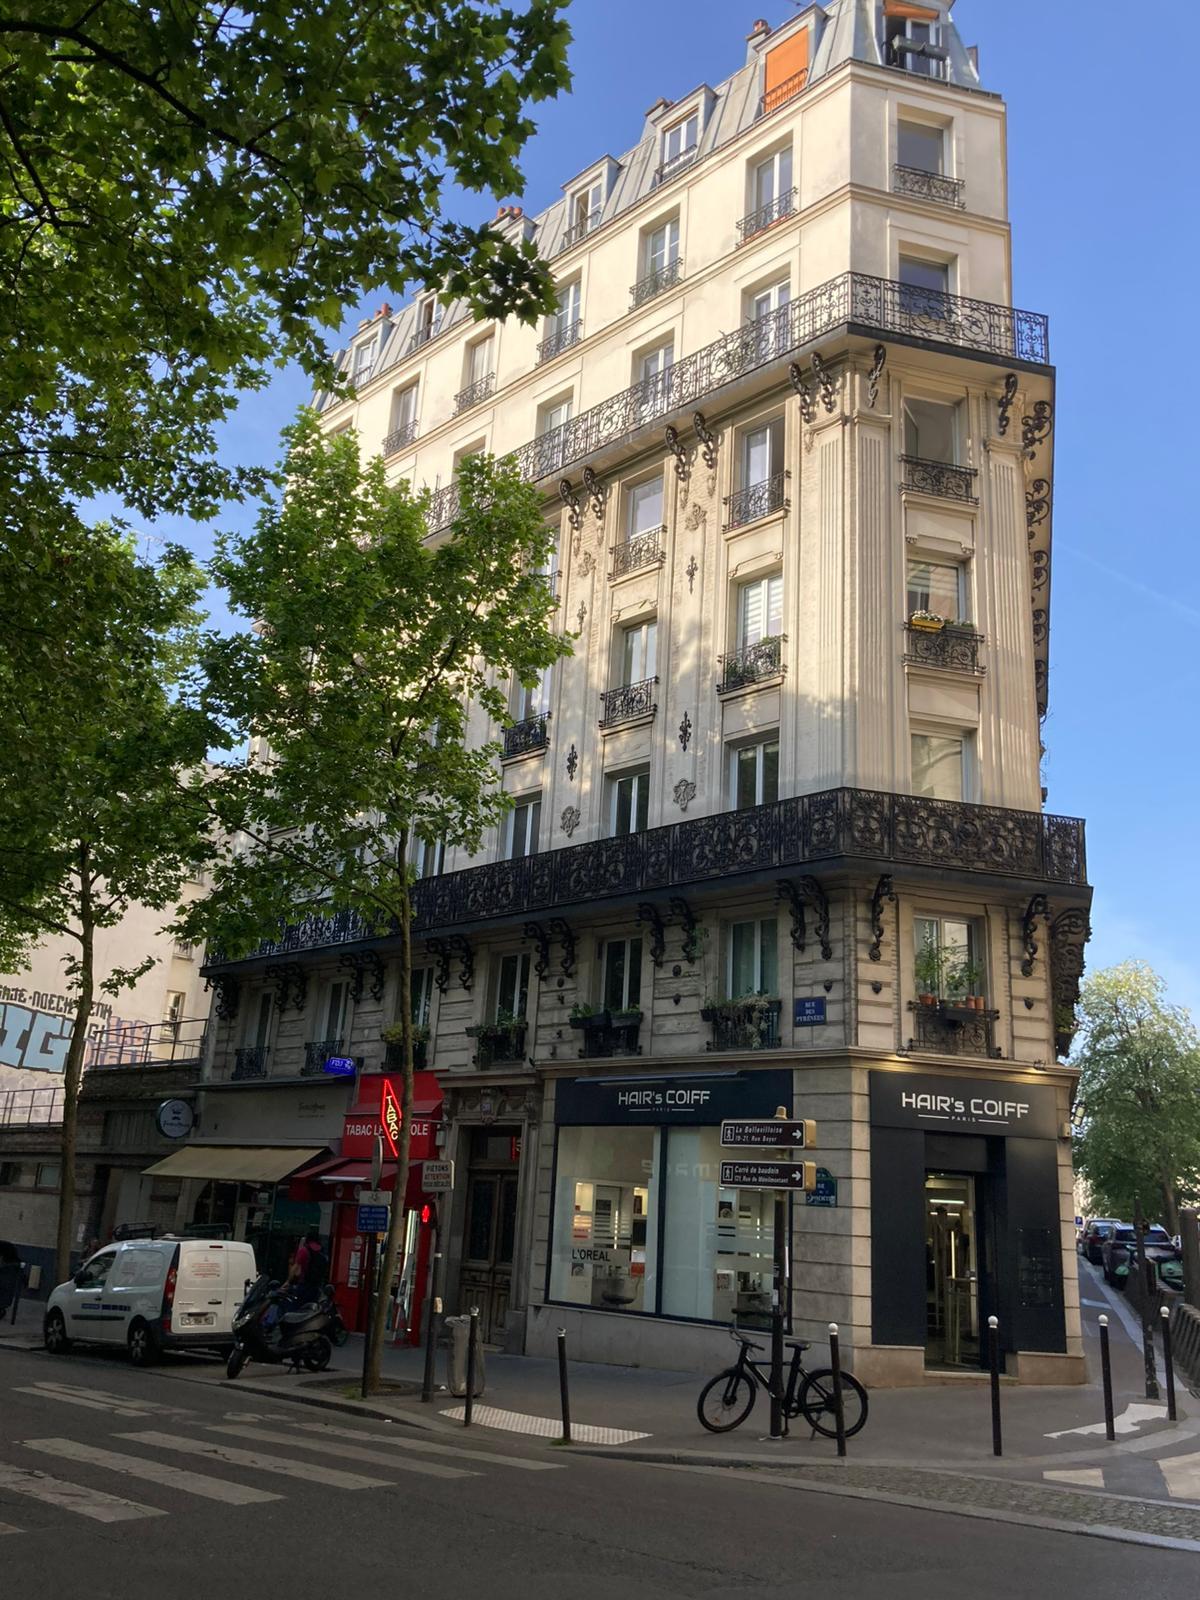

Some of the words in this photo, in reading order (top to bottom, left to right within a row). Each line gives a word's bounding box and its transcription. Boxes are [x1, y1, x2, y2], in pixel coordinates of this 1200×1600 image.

[618, 1091, 663, 1105] HAIR's
[666, 1090, 710, 1104] COIFF
[901, 1092, 965, 1113] HAIR's
[970, 1098, 1030, 1118] COIFF
[385, 1095, 399, 1141] TABAC
[346, 1124, 372, 1136] TABAC
